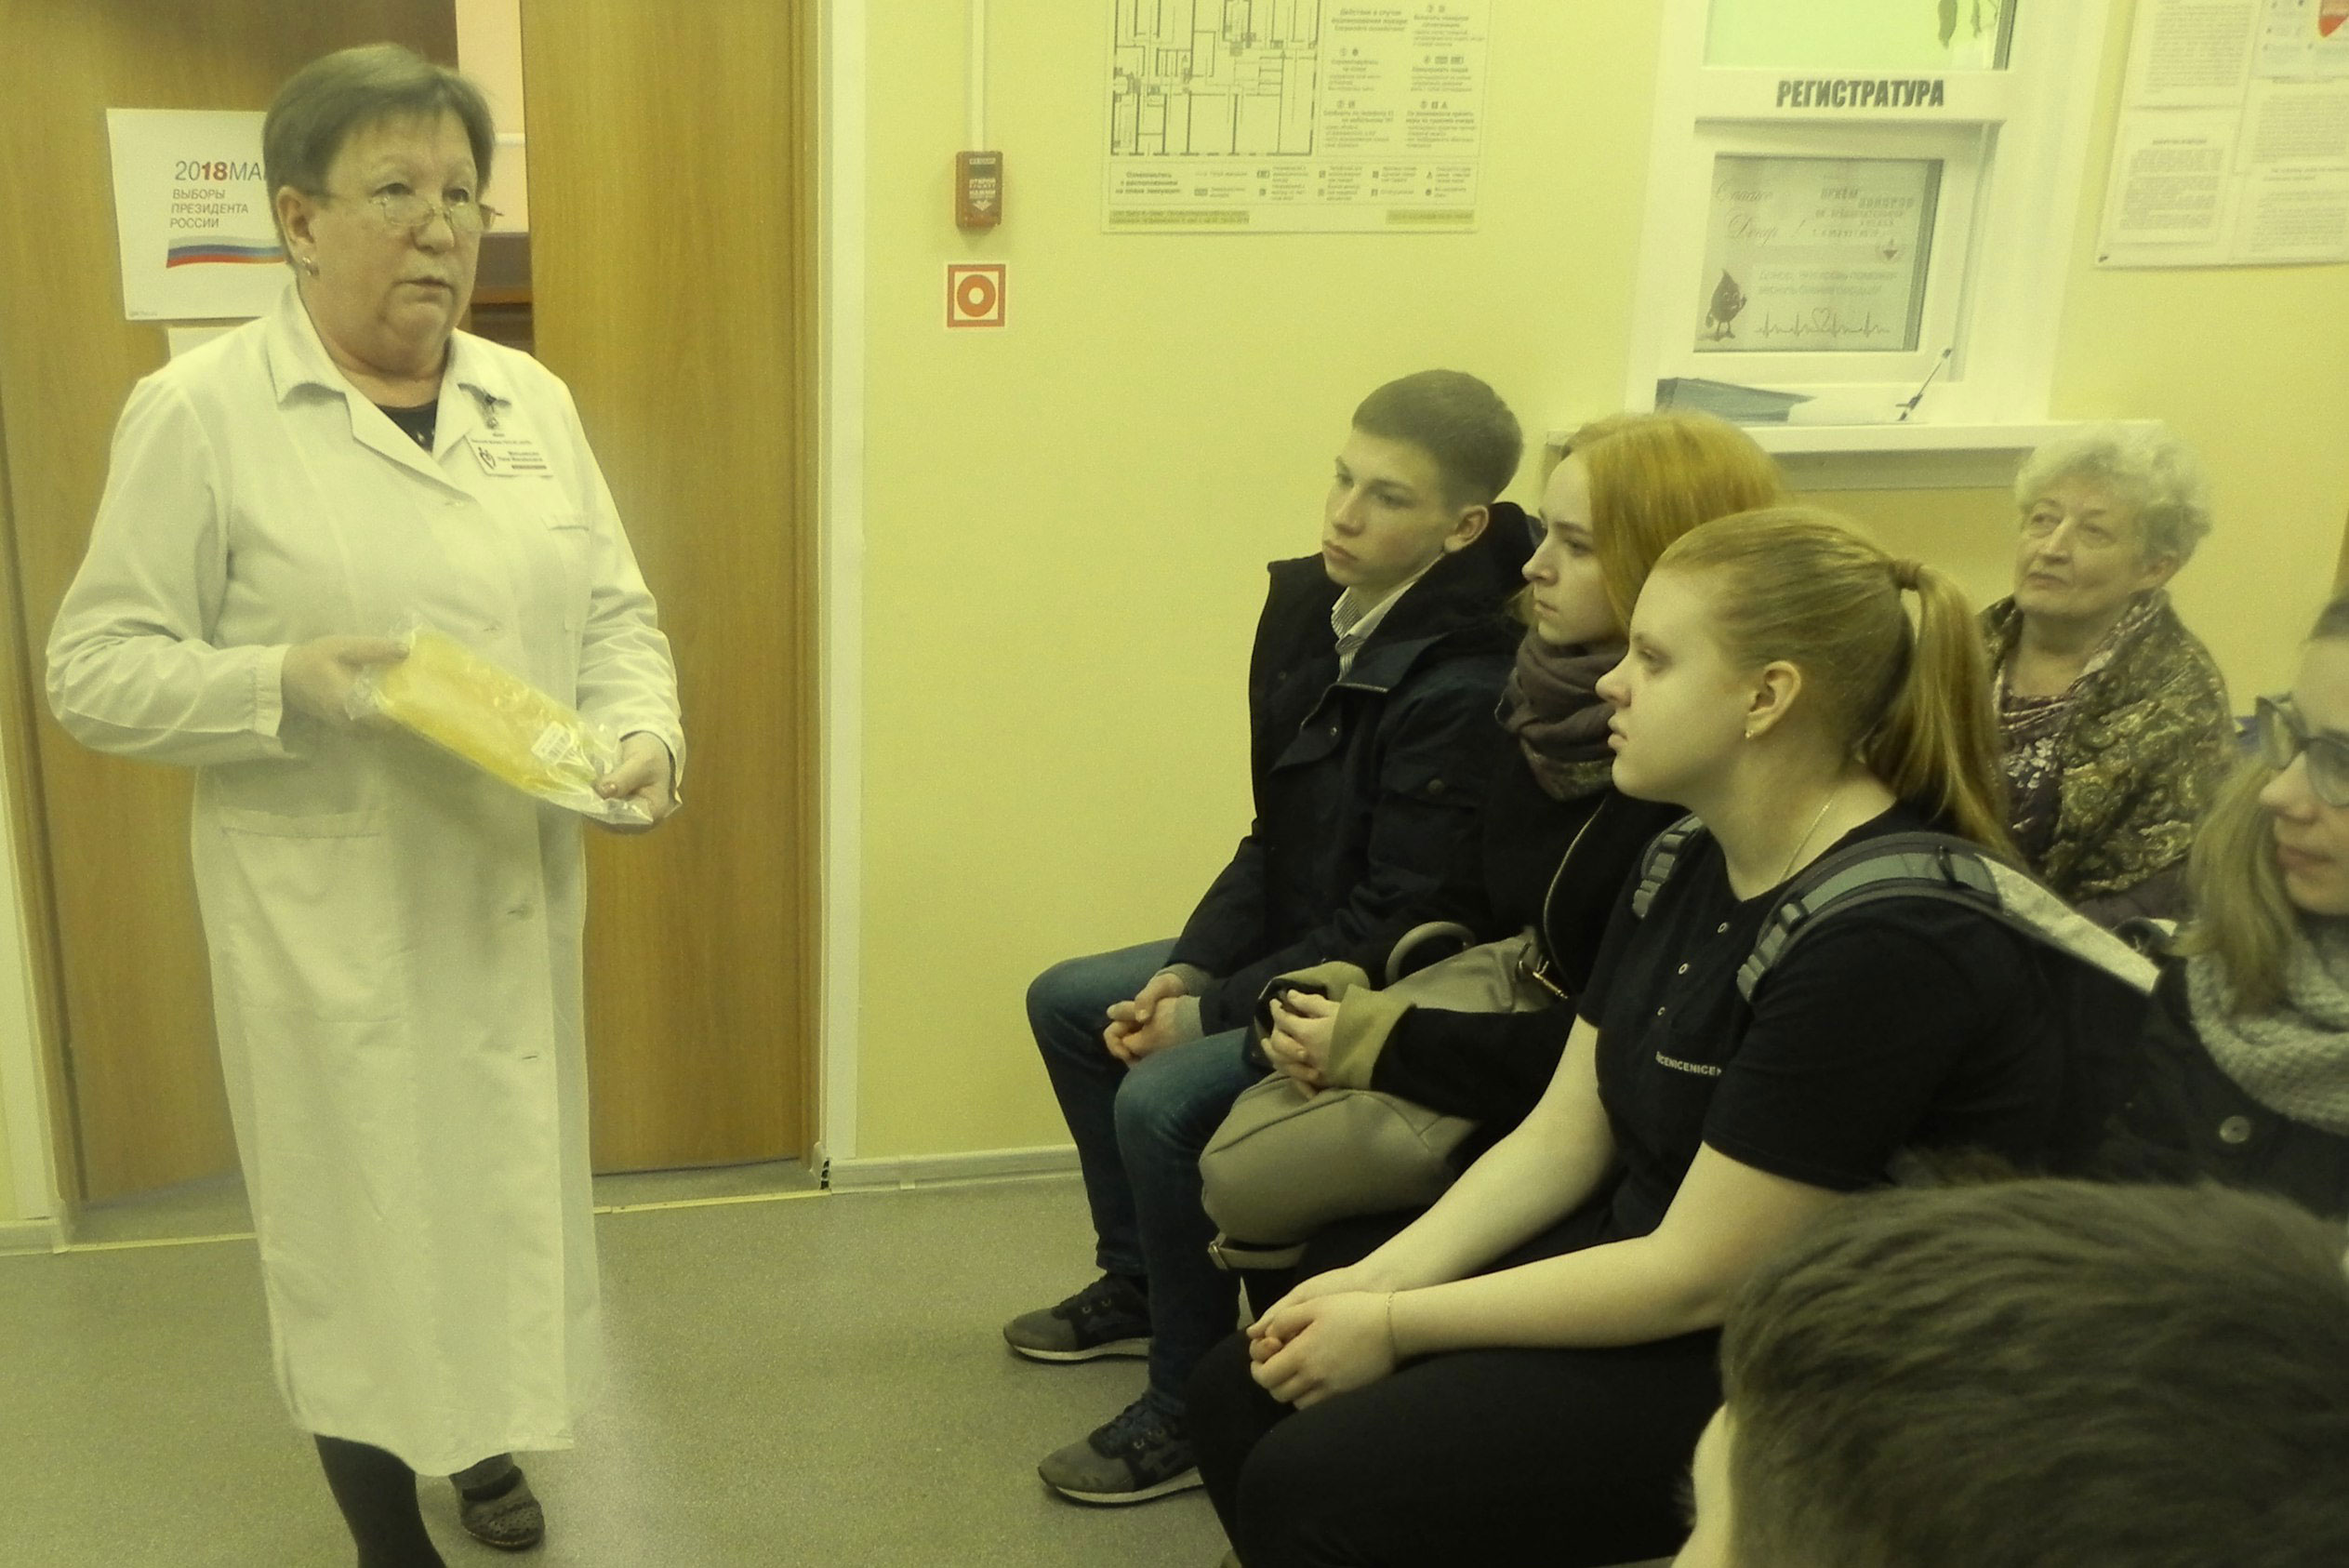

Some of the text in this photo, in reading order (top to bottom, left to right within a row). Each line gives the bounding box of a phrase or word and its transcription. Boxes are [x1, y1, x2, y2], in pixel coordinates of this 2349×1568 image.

[1776, 79, 1945, 108] РЕГИСТРАТУРА
[175, 160, 267, 181] 2018МА
[172, 189, 226, 199] ВЫБОРЫ
[171, 204, 248, 215] ПРЕЗИДЕНТА
[170, 218, 219, 229] РОССИИ
